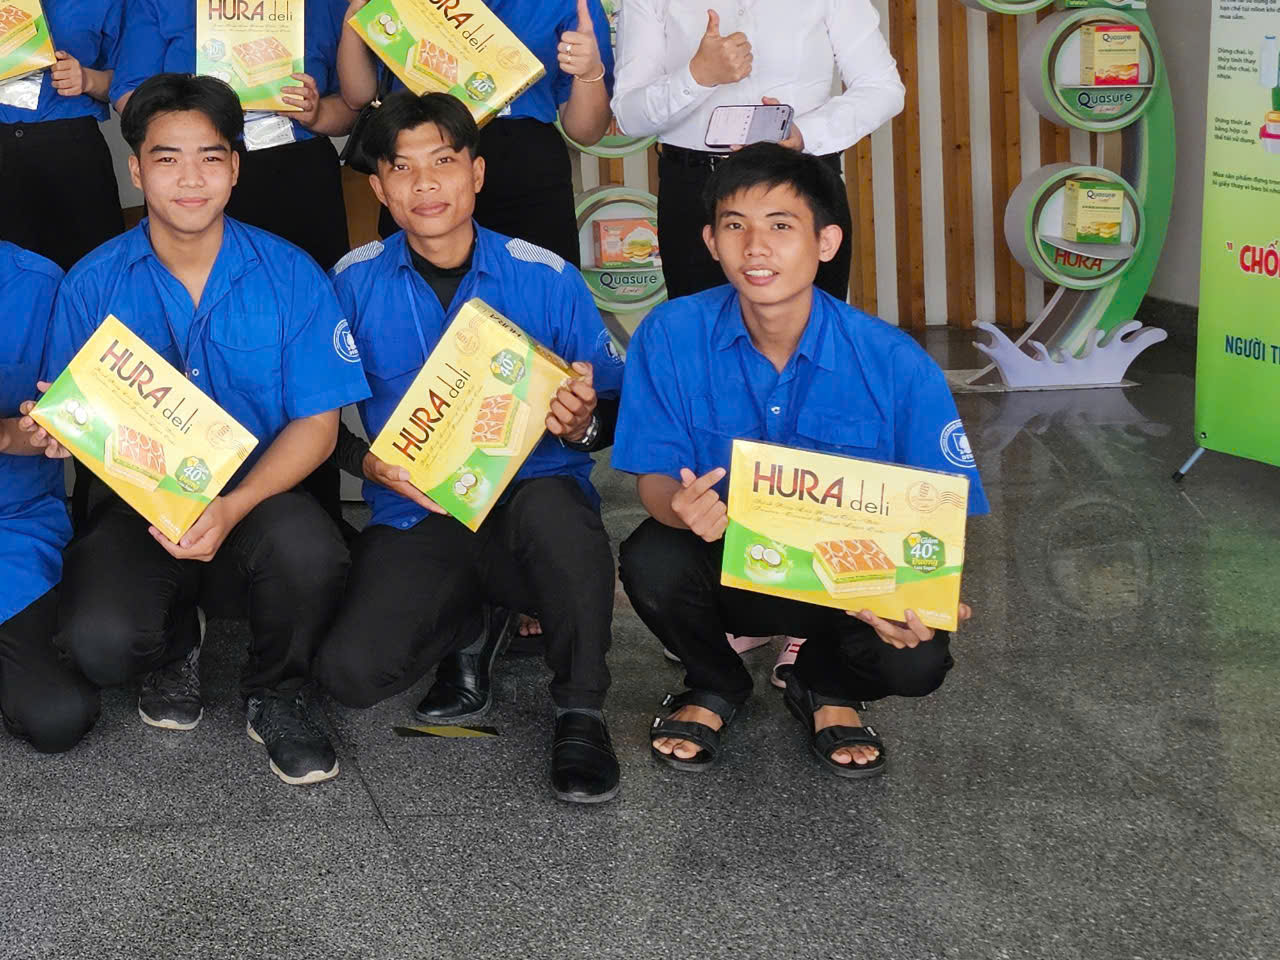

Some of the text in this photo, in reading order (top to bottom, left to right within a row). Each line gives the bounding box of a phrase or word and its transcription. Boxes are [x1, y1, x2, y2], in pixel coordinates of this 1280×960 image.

[208, 0, 293, 22] HURA deli
[462, 24, 495, 53] deli
[1078, 92, 1132, 108] Quasure
[1054, 248, 1102, 271] HURA
[1240, 240, 1280, 278] CHỐ
[600, 272, 657, 289] Quasure
[1271, 344, 1280, 365] T
[99, 339, 172, 409] HURA
[162, 397, 198, 434] deli
[392, 389, 452, 462] HURA
[436, 362, 471, 399] deli
[752, 460, 845, 508] HURA
[849, 479, 889, 517] deli
